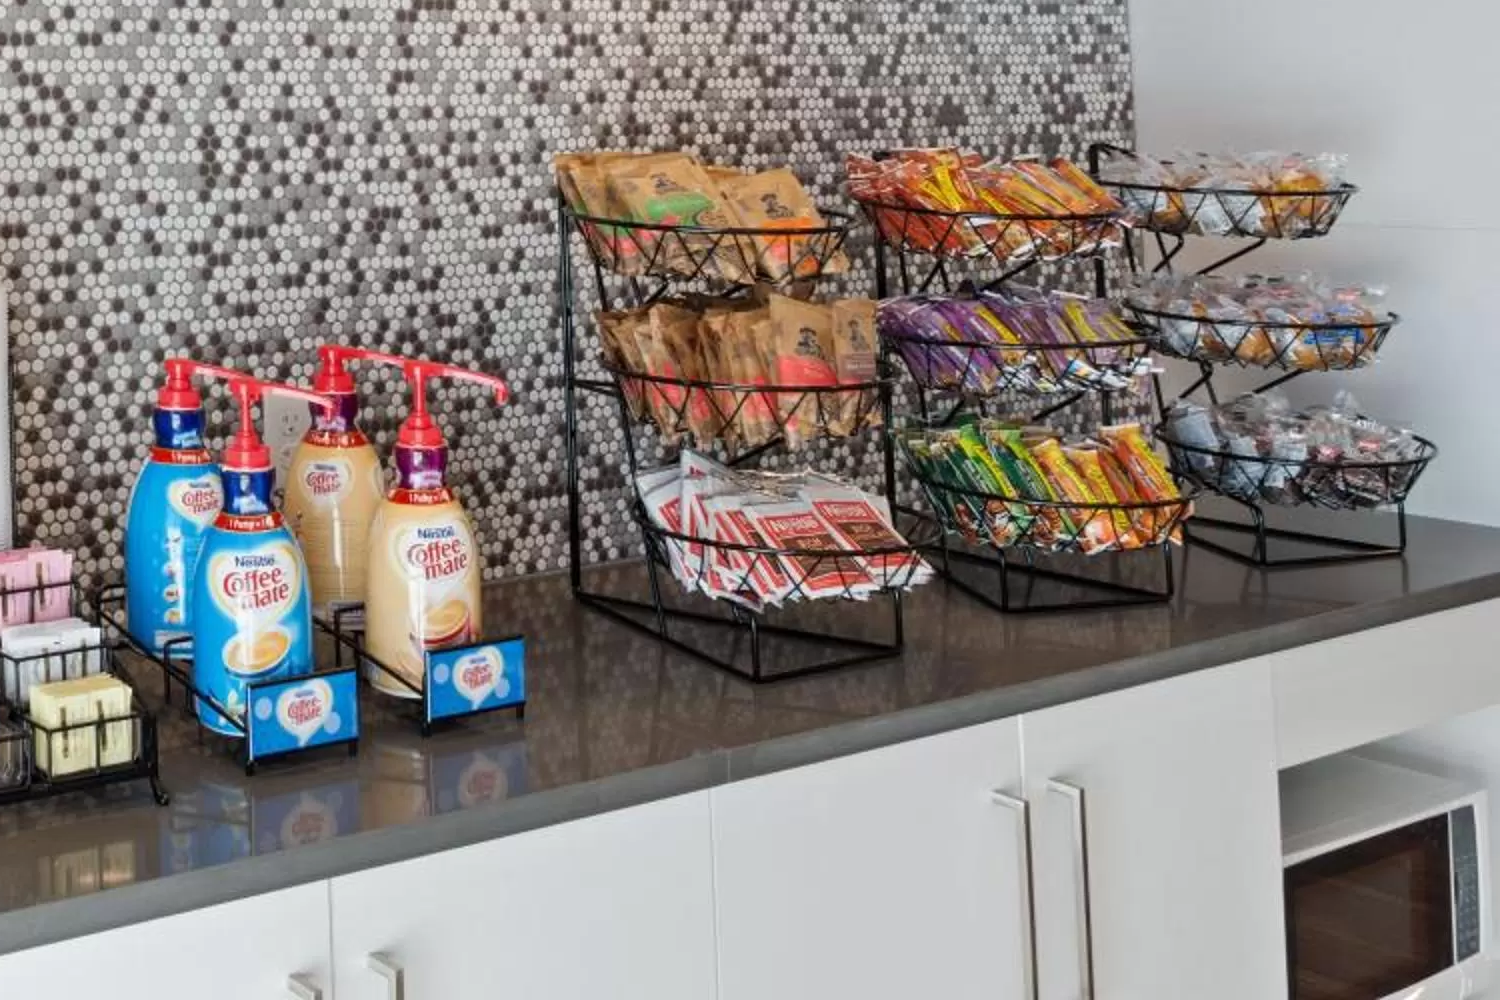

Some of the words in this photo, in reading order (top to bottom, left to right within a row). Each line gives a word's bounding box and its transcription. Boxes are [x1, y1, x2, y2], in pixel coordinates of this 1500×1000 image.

[407, 539, 461, 567] Coffee
[425, 553, 467, 580] mate
[223, 567, 283, 599] Coffee
